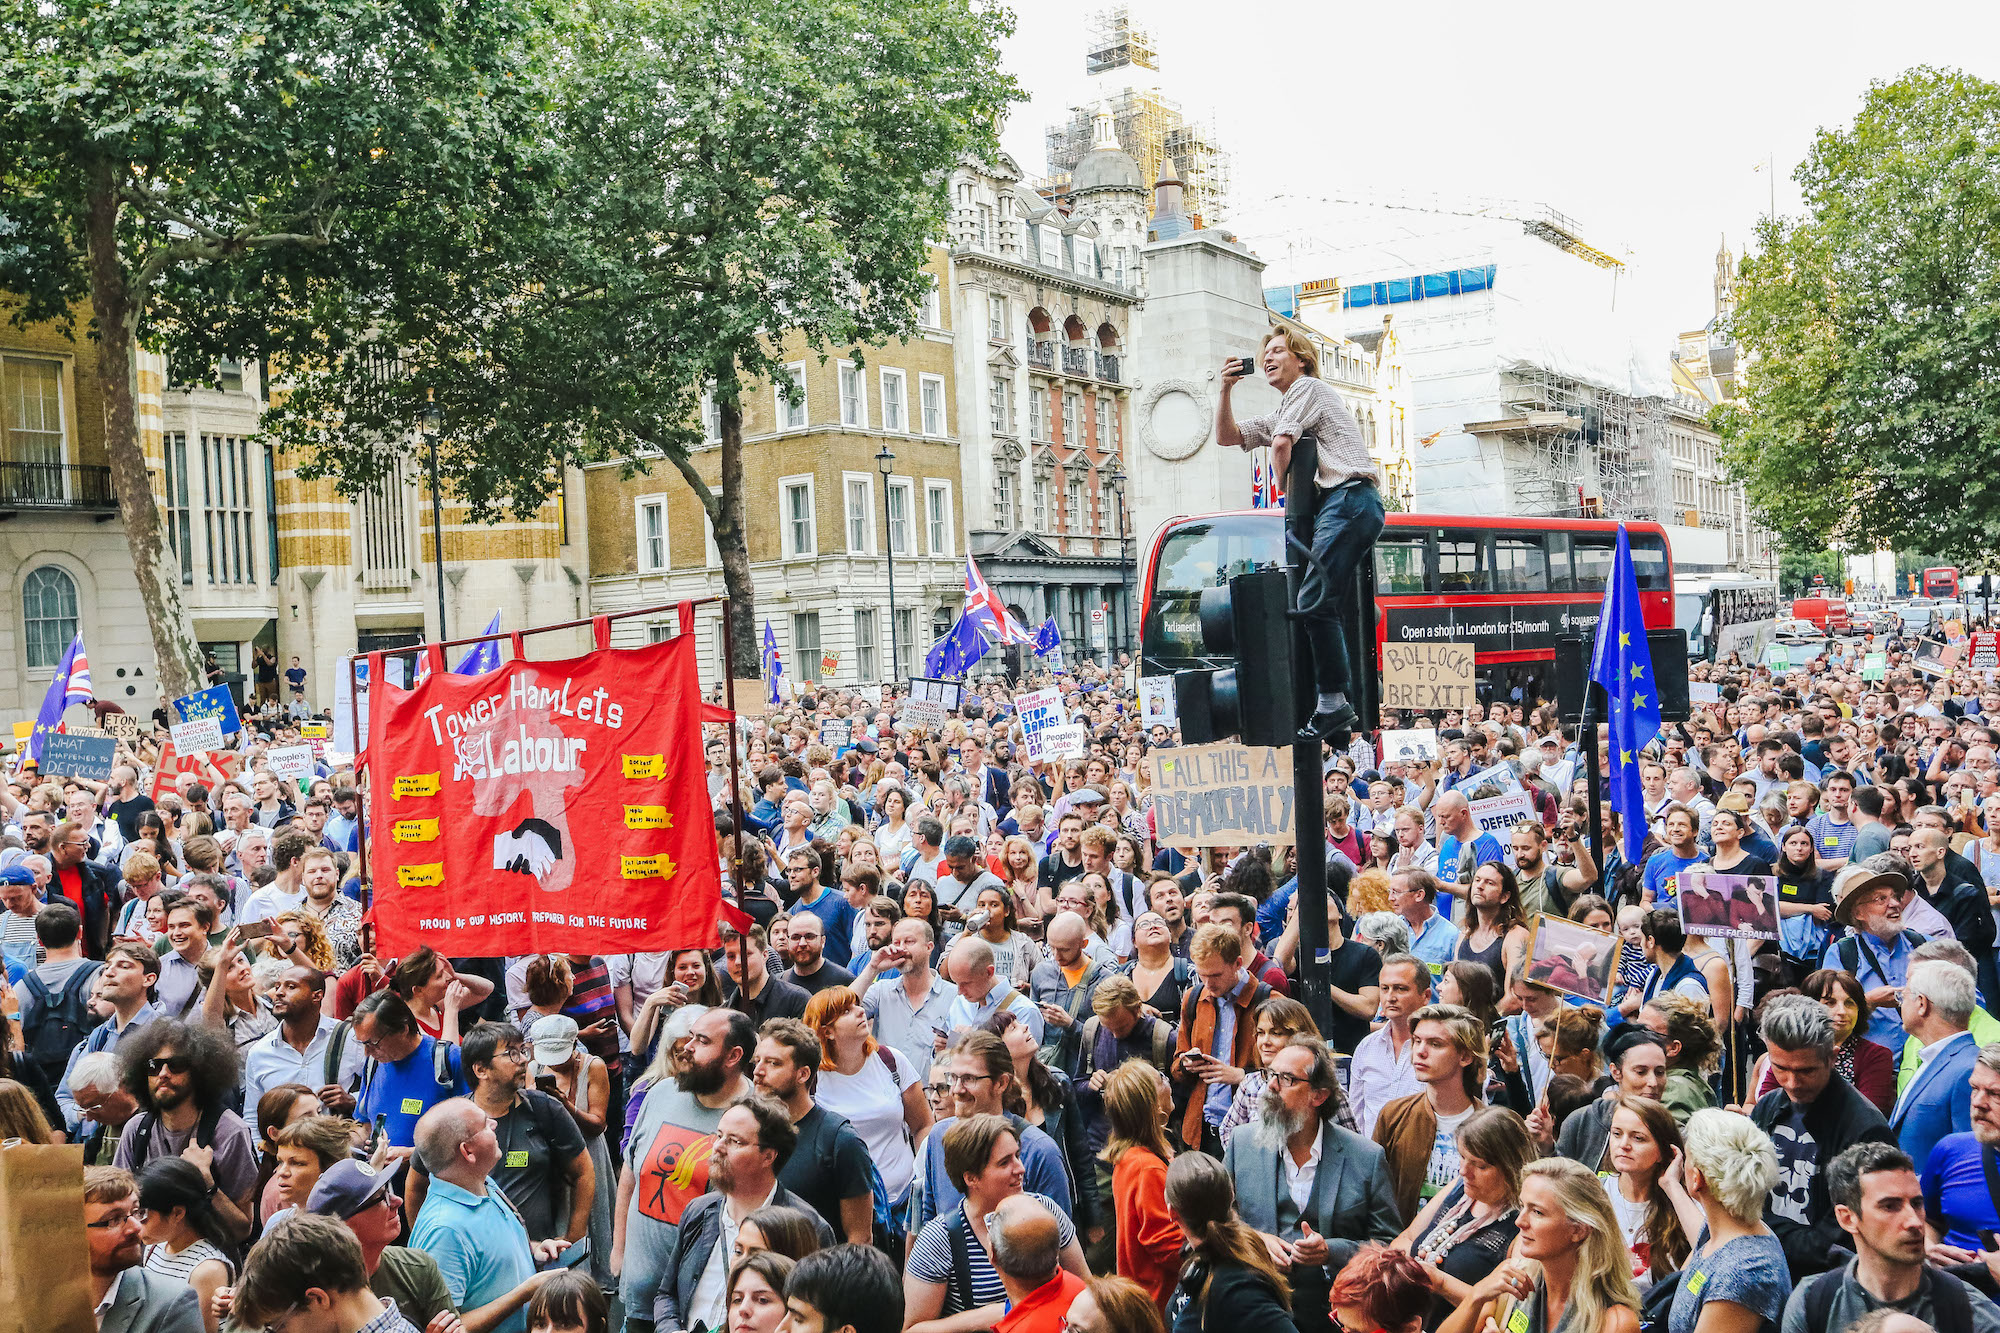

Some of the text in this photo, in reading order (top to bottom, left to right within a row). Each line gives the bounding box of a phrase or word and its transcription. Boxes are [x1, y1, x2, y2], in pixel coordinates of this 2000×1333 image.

[1164, 620, 1196, 633] Parliament
[1401, 620, 1550, 642] Open a shop in London for £15/month
[824, 649, 840, 660] FUCK
[1386, 645, 1474, 679] BOLLOCKS
[820, 665, 837, 676] COUP
[1416, 666, 1438, 682] TO
[1017, 693, 1040, 706] DEFEND
[1388, 683, 1470, 708] BREXIT
[184, 700, 202, 714] WHY
[906, 704, 945, 714] DEMOCRACY
[1019, 696, 1057, 713] DEMOCRACY
[106, 714, 137, 726] ETON
[423, 694, 502, 746] Tower
[1021, 707, 1048, 723] STOP
[181, 721, 208, 731] DEFEND
[1024, 715, 1060, 734] BORIS!
[104, 726, 134, 737] MESS
[174, 724, 219, 739] DEMOCRACY
[1046, 731, 1078, 741] People's
[49, 737, 85, 750] WHAT
[178, 736, 219, 749] PARLIAMENT
[180, 735, 201, 744] RESIST
[1026, 732, 1042, 745] ST
[1053, 740, 1072, 749] Vote
[181, 742, 220, 753] SHUTDOWN
[486, 723, 587, 779] Labour
[48, 751, 97, 762] HAPPENED
[272, 752, 305, 763] People's
[46, 761, 112, 779] DEMOCRACY
[280, 762, 300, 770] Vote
[1157, 748, 1279, 789] CALL THIS A
[1470, 796, 1524, 812] Workers' Liberty
[1155, 784, 1295, 840] DEMOCRACY
[1480, 811, 1527, 832] DEFEND
[1446, 870, 1456, 880] EU
[419, 918, 451, 930] PROUD
[455, 917, 466, 929] OF
[469, 915, 485, 926] OUR
[532, 911, 565, 926] PREPARED
[568, 914, 585, 928] FOR
[587, 915, 606, 928] THE
[609, 917, 648, 930] FUTURE
[1689, 926, 1777, 940] DOUBLE FACEPALM.
